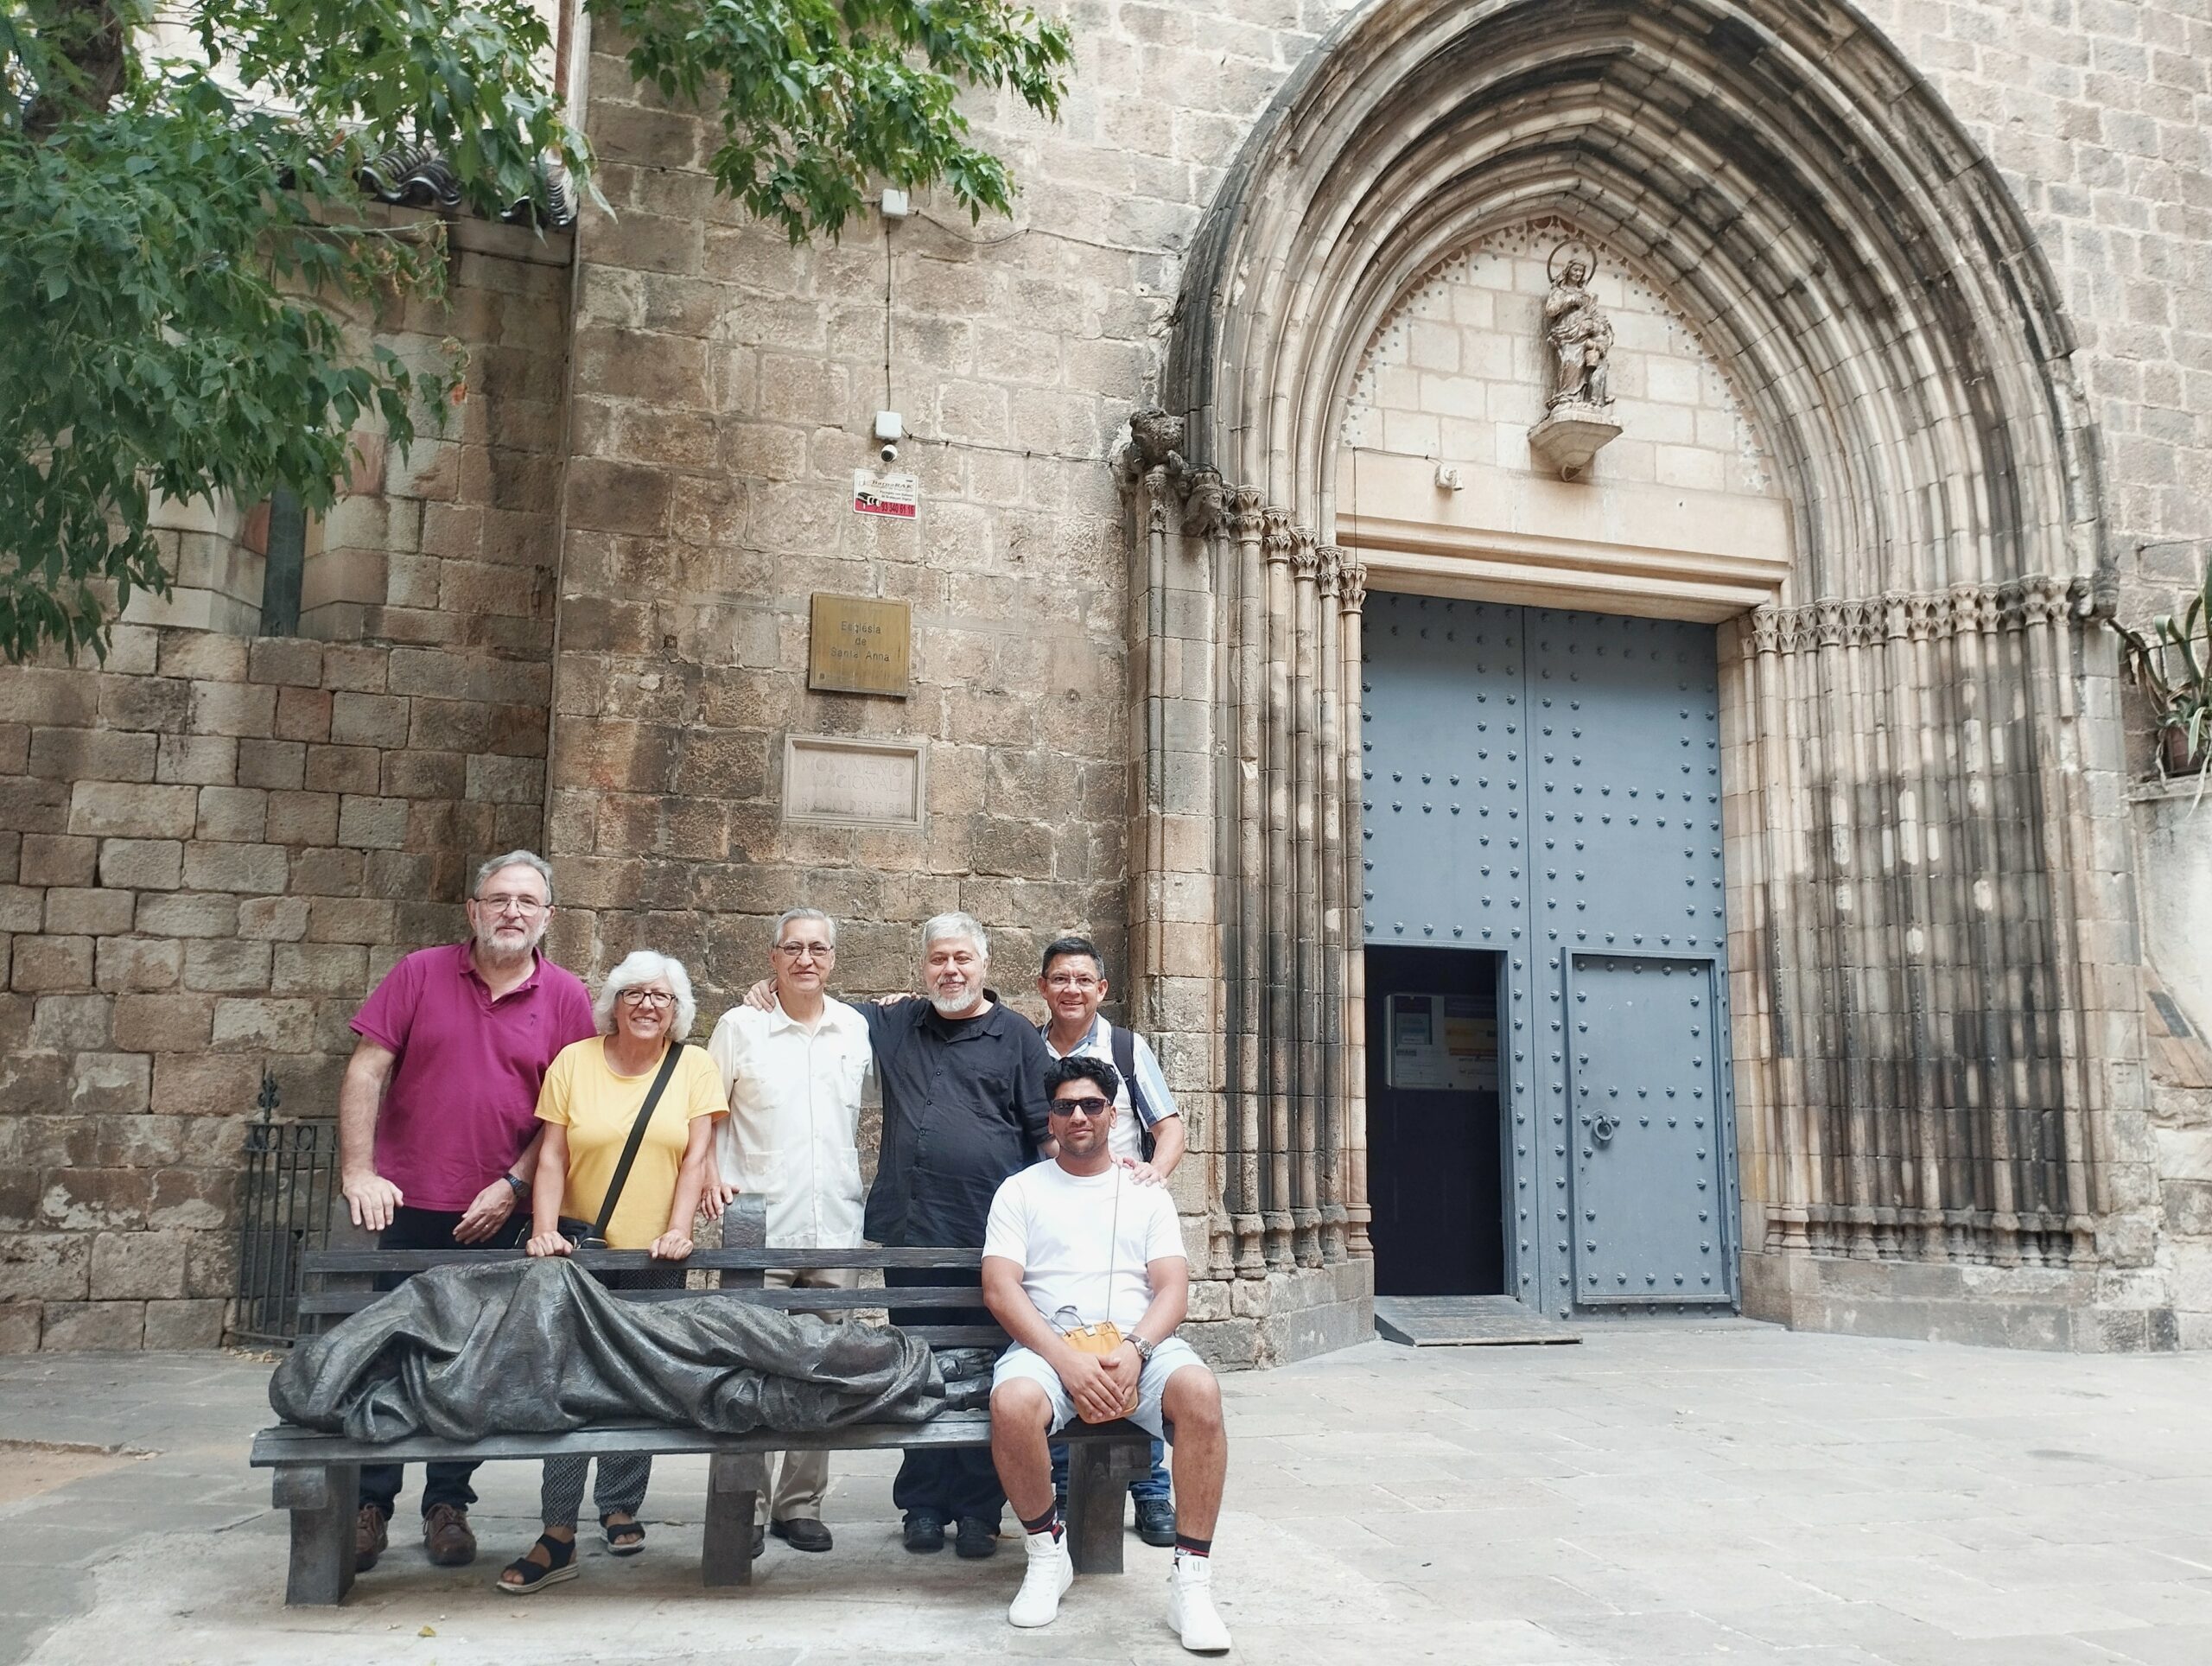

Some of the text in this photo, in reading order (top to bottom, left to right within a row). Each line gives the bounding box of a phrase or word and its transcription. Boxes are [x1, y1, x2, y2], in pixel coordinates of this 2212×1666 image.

[855, 636, 867, 646] de
[830, 646, 890, 662] Santa Anna
